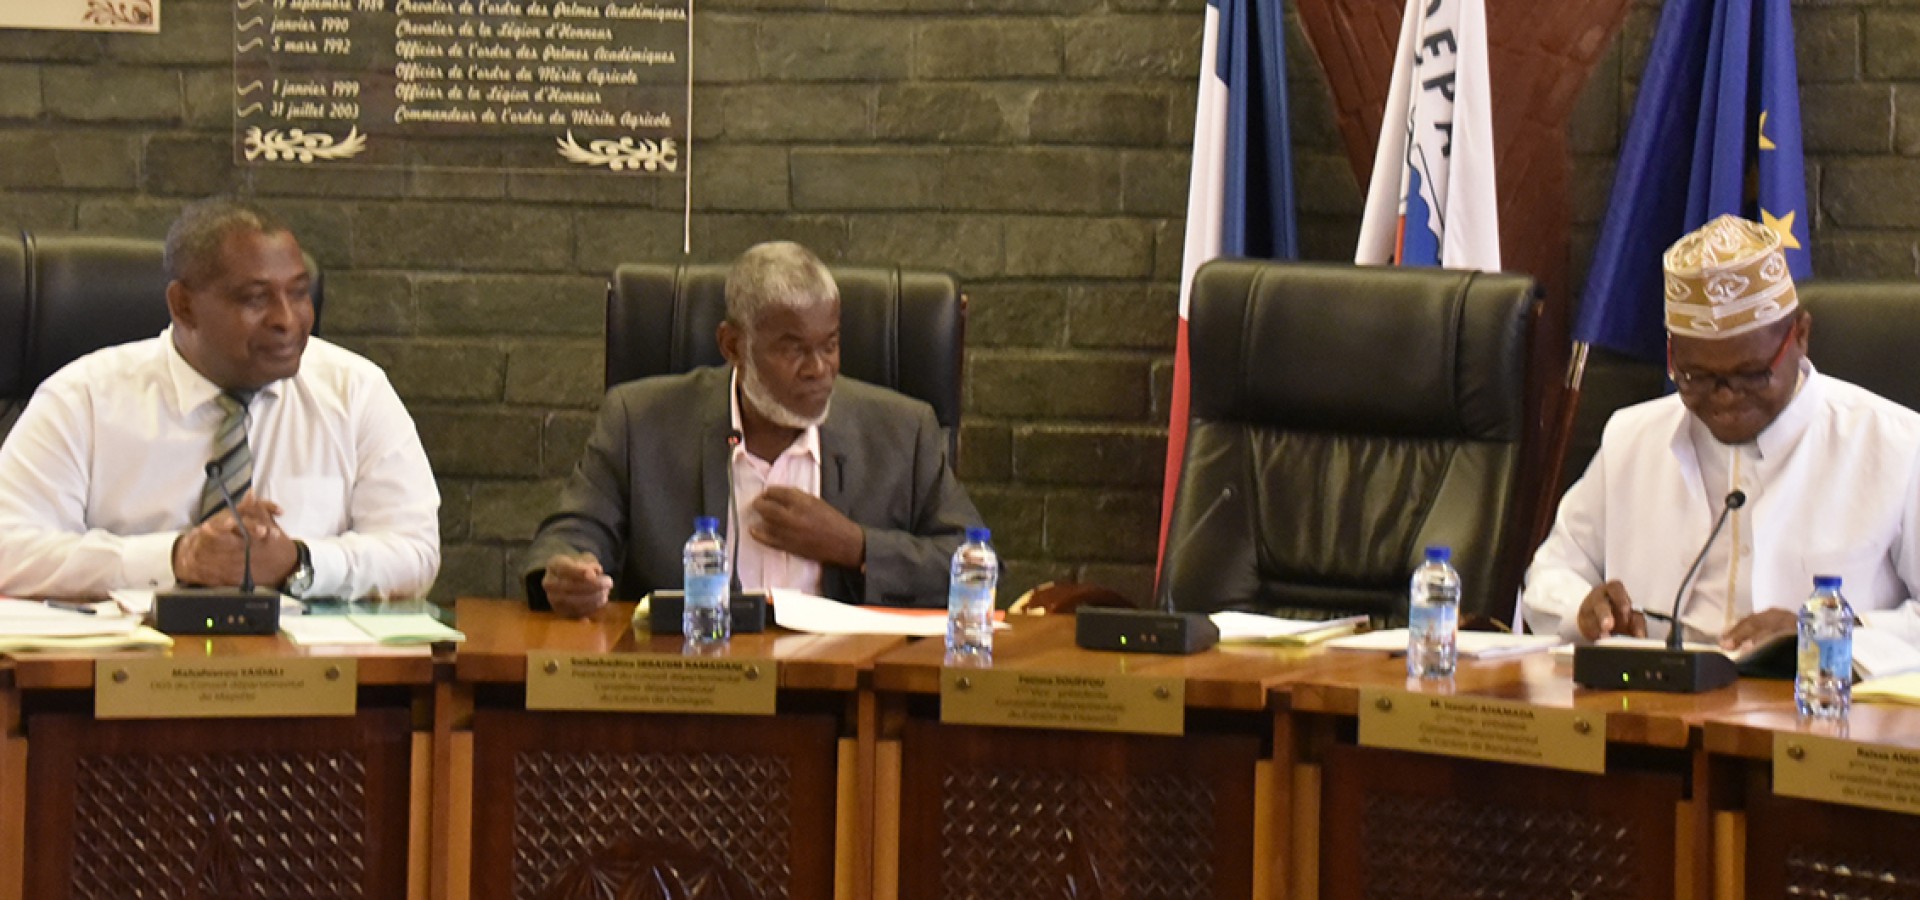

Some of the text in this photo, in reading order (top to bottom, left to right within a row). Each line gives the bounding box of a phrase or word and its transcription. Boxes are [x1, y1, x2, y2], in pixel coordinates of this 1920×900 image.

[395, 0, 686, 24] Chevalier de l'ordre des Palmes Académiques
[270, 15, 349, 34] janvier 1990
[395, 18, 614, 41] Chevalier de la Légion d'Honneur
[271, 36, 351, 54] 5 mars 1992
[395, 39, 676, 66] Officier de l'ordre des Palmes Académiques
[395, 61, 638, 87] Officier de l'ordre du Mérite Agricole
[272, 79, 360, 98] 1 janvier 1999
[395, 82, 602, 105] Officier de la Légion d'Honneur
[270, 101, 360, 120] 31 juillet 2003
[394, 105, 672, 131] Commandeur de l'ordre du Mérite Agricole
